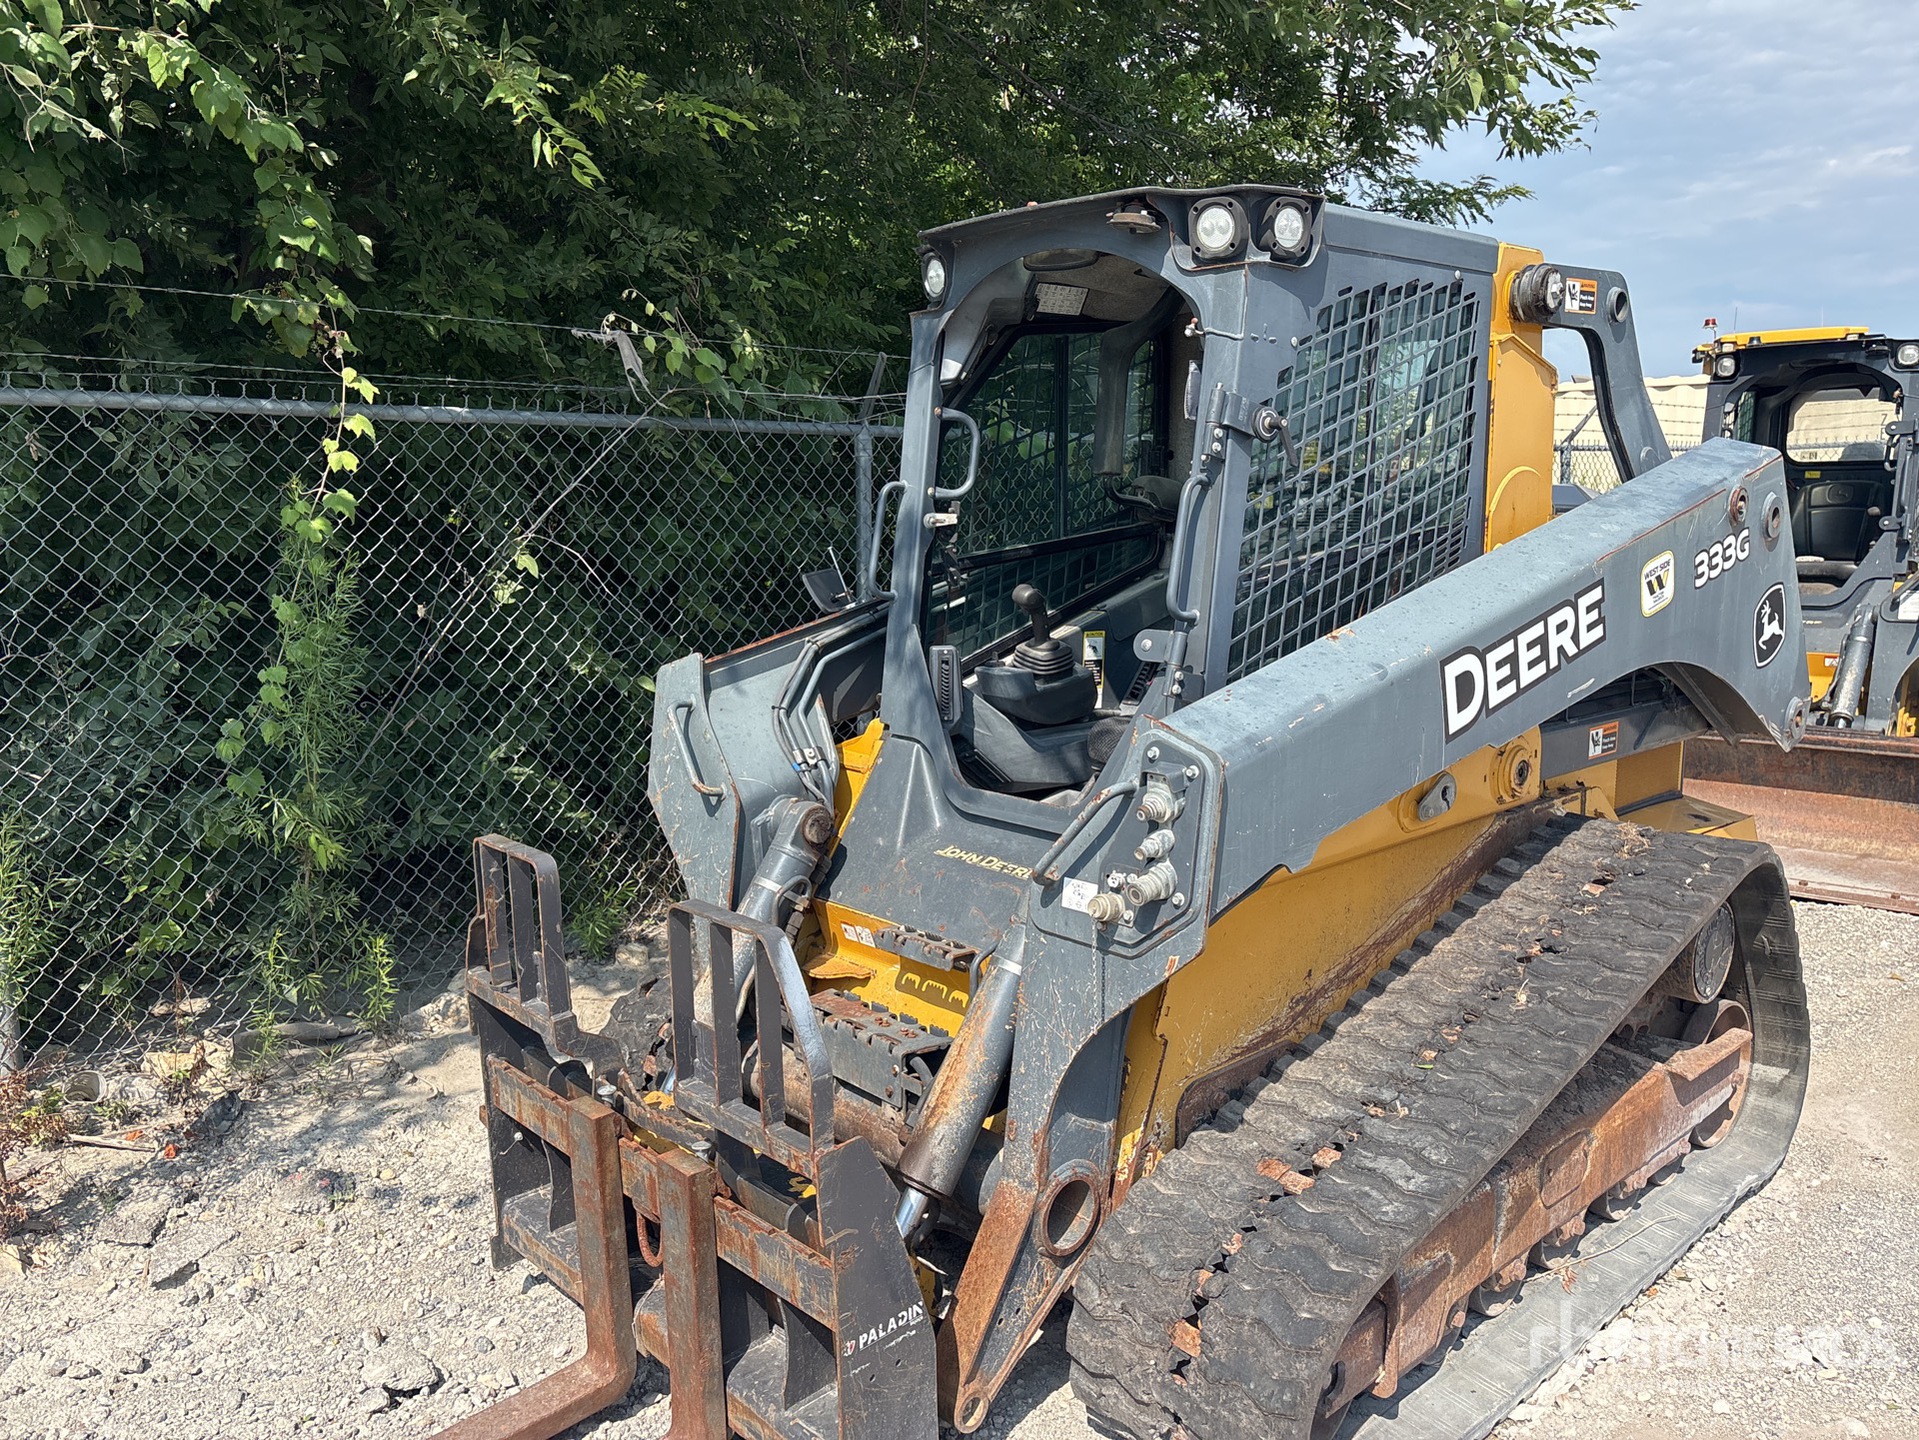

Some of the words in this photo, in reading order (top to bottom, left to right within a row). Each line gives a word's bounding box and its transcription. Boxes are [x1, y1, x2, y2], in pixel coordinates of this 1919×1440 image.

[1644, 566, 1659, 580] WEST
[1660, 558, 1670, 571] SIDE
[1694, 528, 1750, 588] 333G
[1443, 585, 1604, 735] DEERE
[933, 845, 983, 865] JOHN
